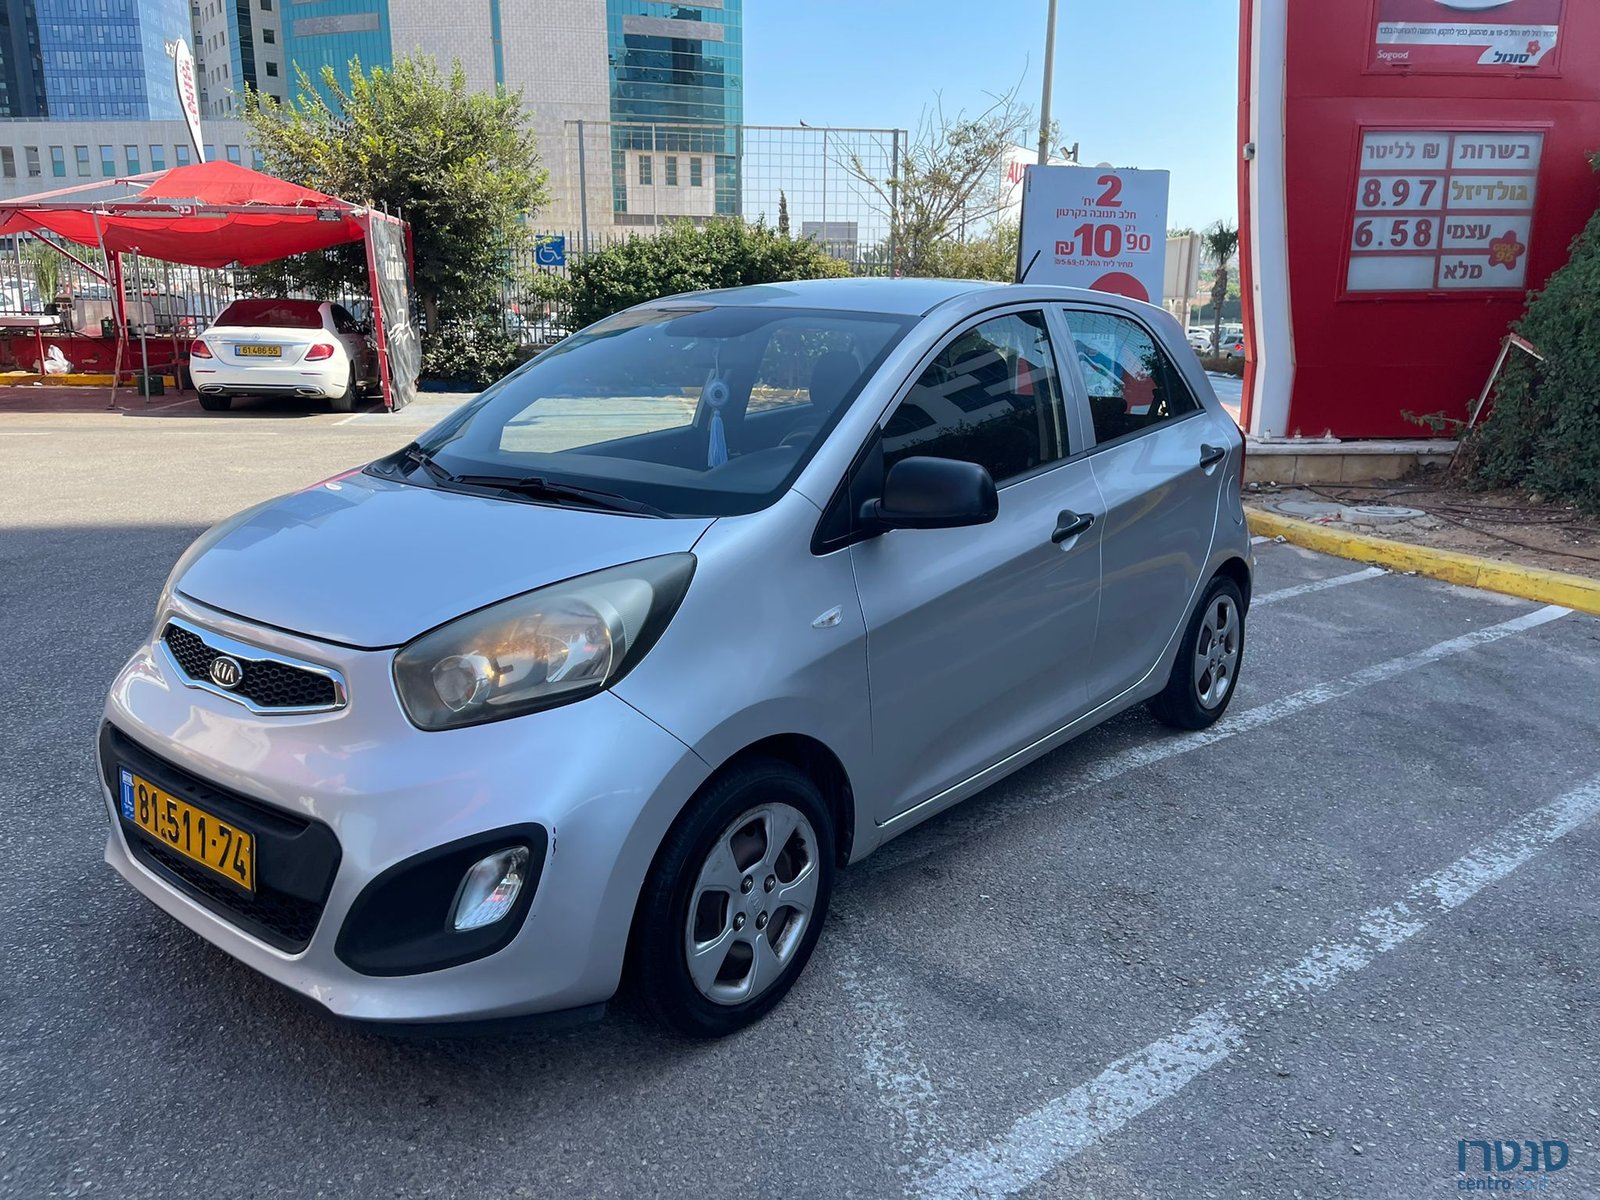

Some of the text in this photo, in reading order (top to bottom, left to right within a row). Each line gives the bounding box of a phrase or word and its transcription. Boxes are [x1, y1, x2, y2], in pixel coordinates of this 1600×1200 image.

[1377, 49, 1410, 61] Sogood
[1493, 51, 1530, 63] סונול
[1366, 141, 1416, 159] לליטר
[1460, 143, 1530, 159] בשרות
[1095, 174, 1123, 207] 2
[1362, 178, 1437, 207] 8.97
[1452, 180, 1528, 201] גולדיזל
[1056, 208, 1136, 219] חלב תנובה בקרטון
[1355, 218, 1432, 247] 6.58
[1446, 224, 1491, 240] עצמי
[1443, 261, 1483, 279] מלא
[213, 660, 235, 682] KIA
